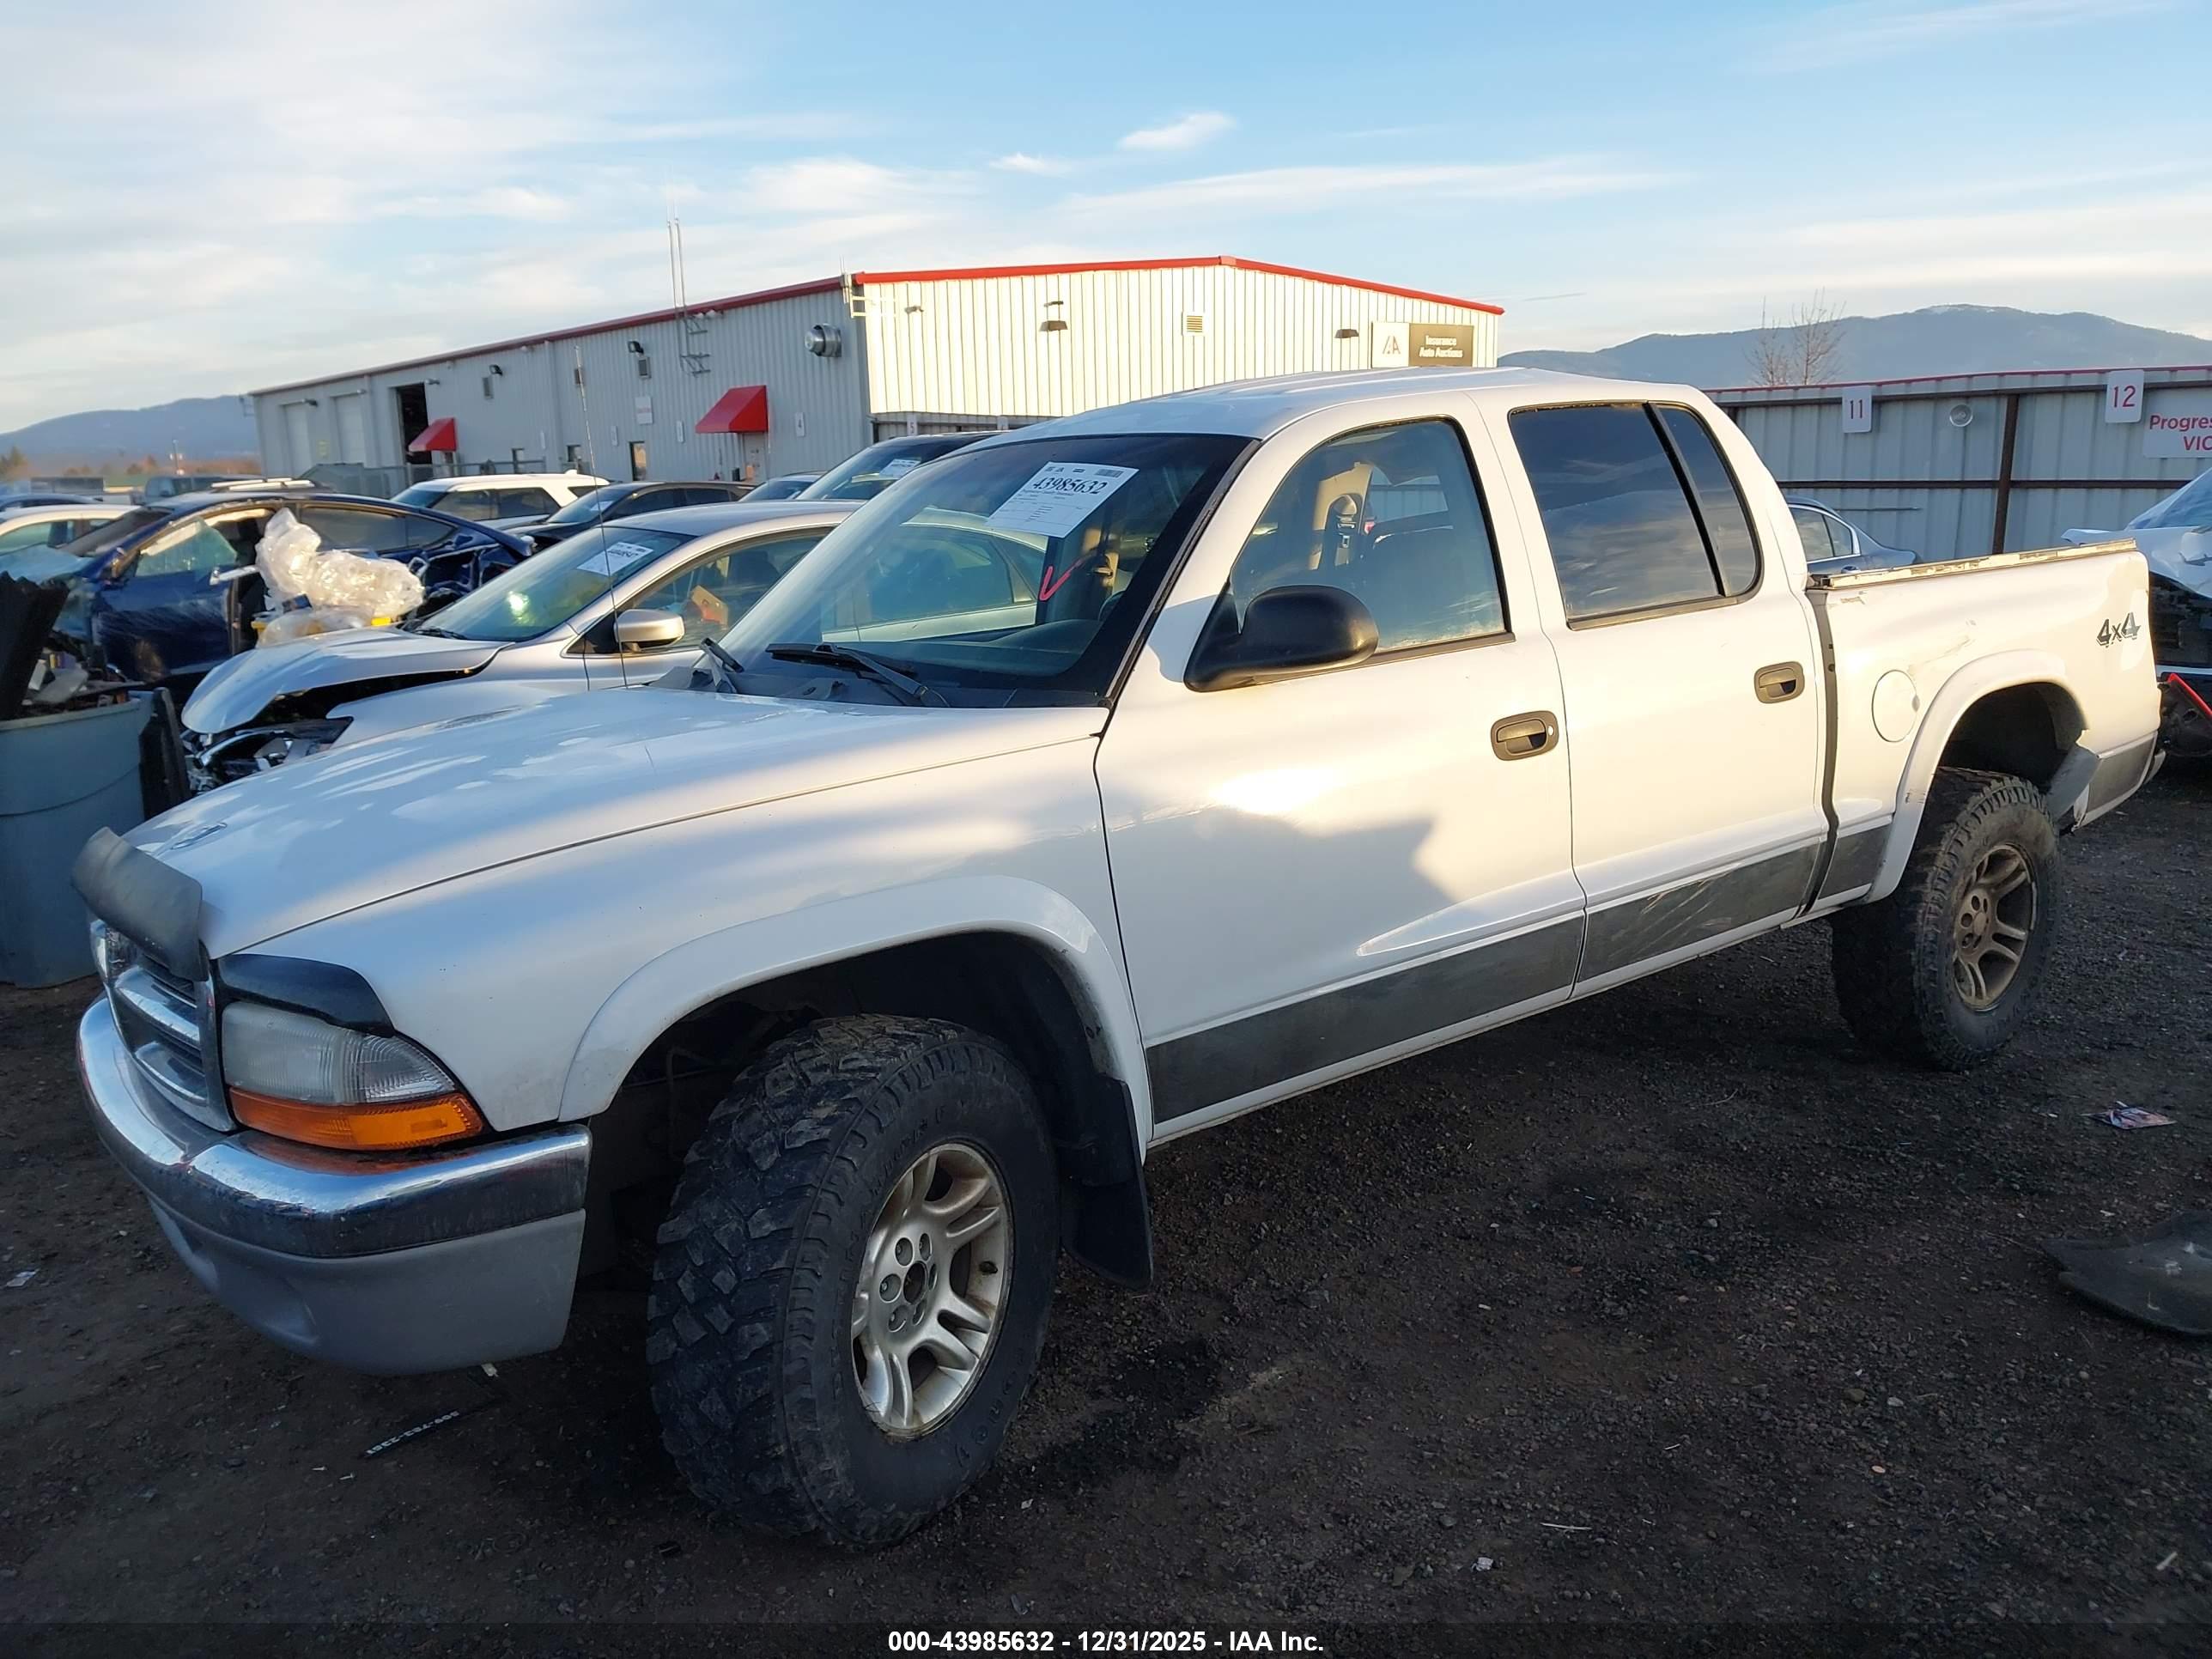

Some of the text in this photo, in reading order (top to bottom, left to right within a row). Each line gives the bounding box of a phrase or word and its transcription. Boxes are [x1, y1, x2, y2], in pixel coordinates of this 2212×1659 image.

[2113, 386, 2136, 408] 12
[1850, 398, 1863, 420] 11
[1032, 477, 1109, 495] 43985632
[2095, 611, 2142, 648] 4x4
